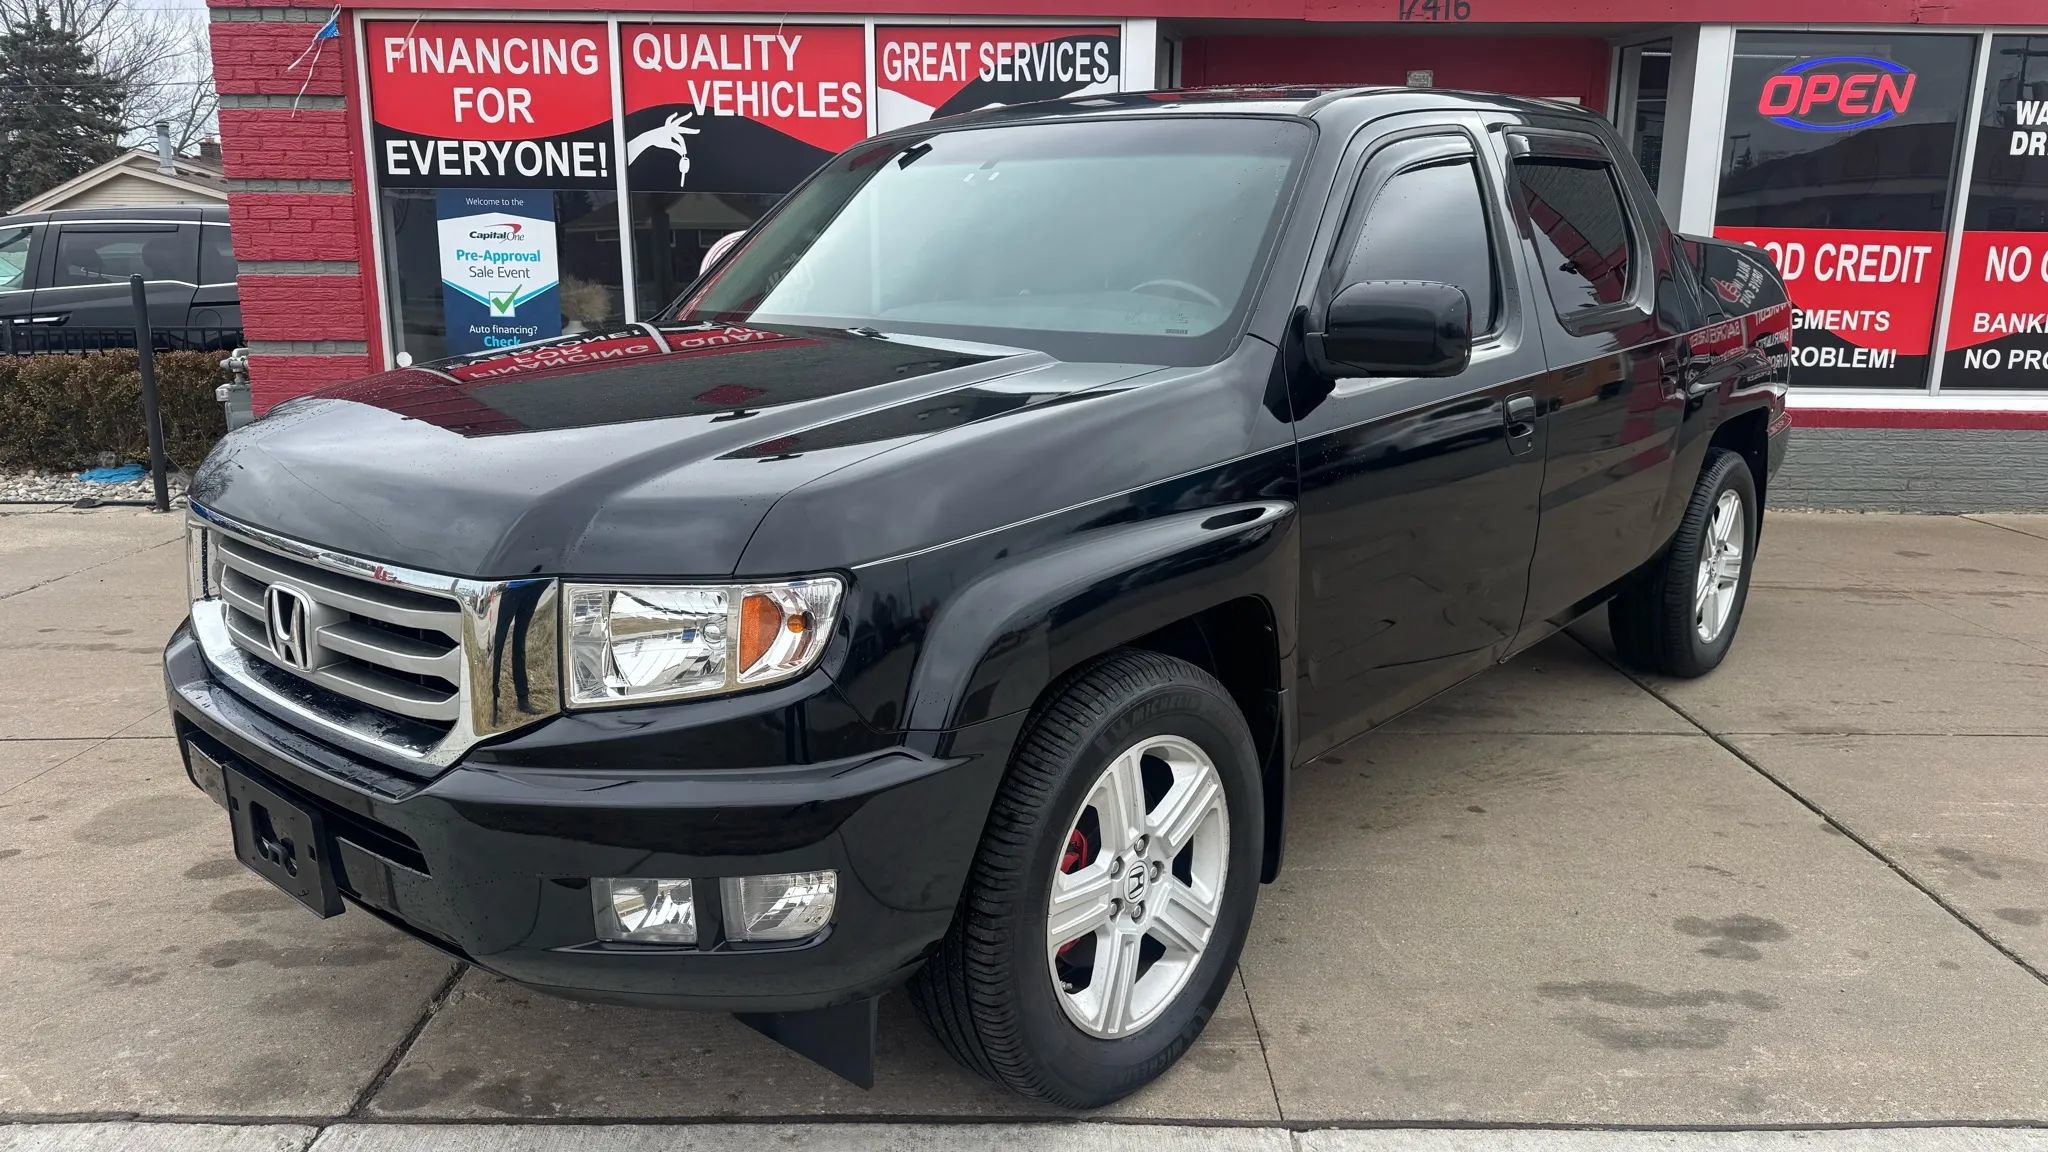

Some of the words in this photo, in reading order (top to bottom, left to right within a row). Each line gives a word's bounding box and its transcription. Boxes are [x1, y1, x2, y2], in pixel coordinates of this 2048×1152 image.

[384, 37, 599, 75] FINANCING
[632, 32, 803, 73] QUALITY
[882, 41, 971, 82] GREAT
[978, 41, 1109, 83] SERVICES
[453, 86, 535, 123] FOR
[687, 80, 863, 119] VEHICLES
[1758, 72, 1917, 116] OPEN
[385, 140, 608, 177] EVERYONE!
[2009, 131, 2048, 156] DR
[465, 197, 500, 206] Welcome
[501, 198, 510, 206] to
[511, 198, 524, 206] the
[456, 249, 541, 265] Pre-Approval
[469, 266, 494, 278] Sale
[497, 267, 531, 279] Event
[1814, 242, 1932, 283] CREDIT
[1984, 245, 2033, 283] NO
[469, 325, 490, 334] Auto
[492, 325, 538, 336] financing?
[483, 336, 521, 347] Check
[1973, 312, 2048, 334] BANK
[1964, 348, 2001, 370] NO
